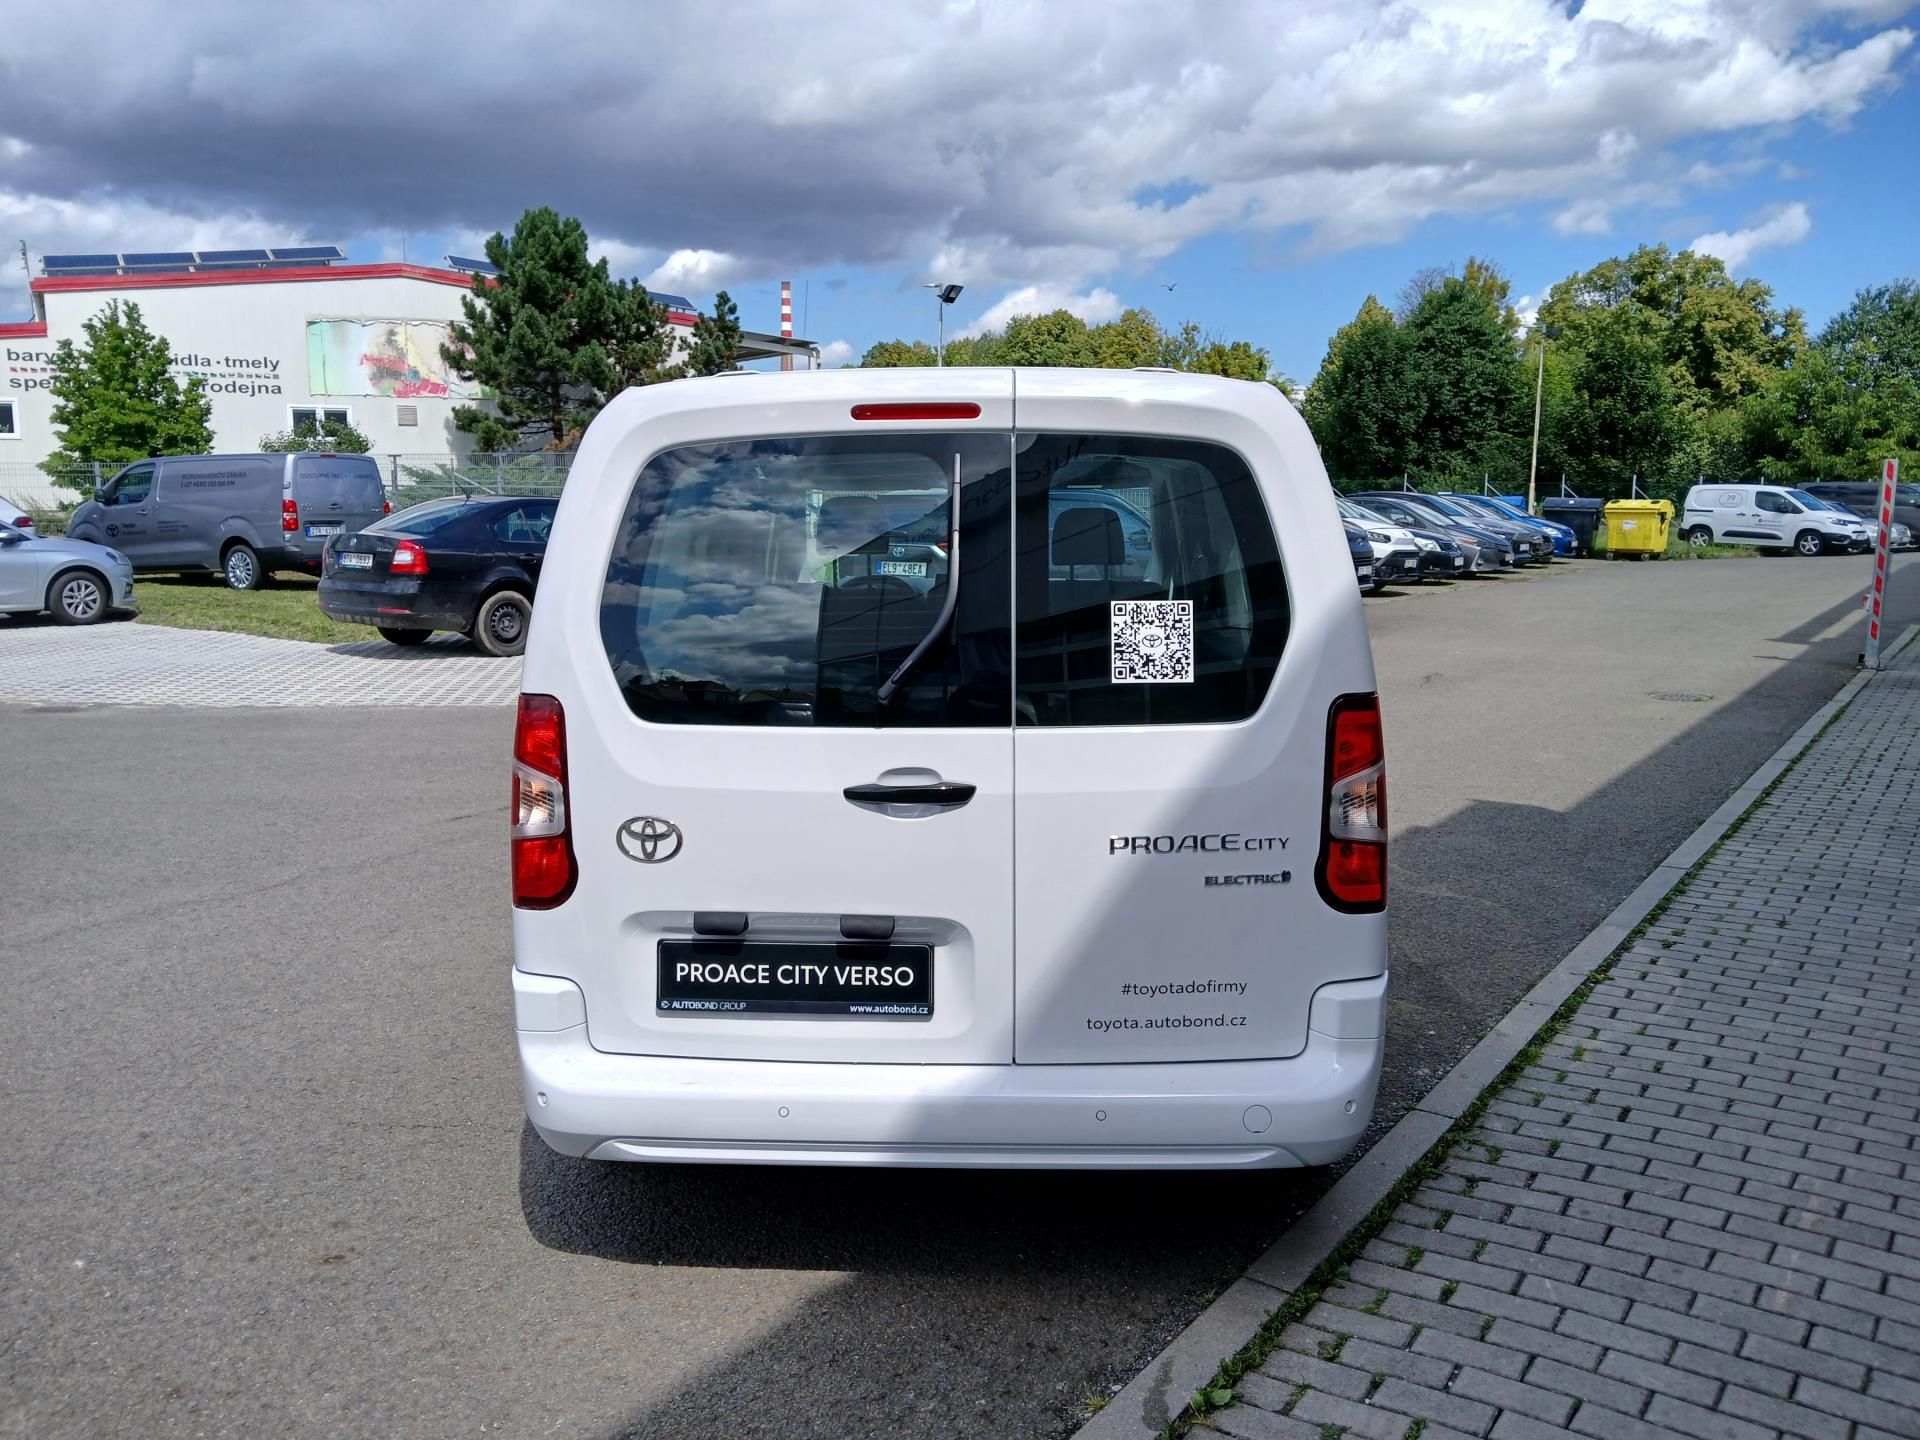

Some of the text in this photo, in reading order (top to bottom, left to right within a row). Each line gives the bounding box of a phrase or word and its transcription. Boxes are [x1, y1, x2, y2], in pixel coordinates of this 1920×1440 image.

[173, 353, 212, 367] idla
[224, 356, 280, 372] tmely
[882, 562, 897, 574] EL9
[1109, 834, 1290, 855] PROACE CITY
[1204, 873, 1282, 887] ELECTRIC
[676, 963, 914, 986] PROACE CITY VERSO
[1121, 980, 1248, 998] #toyotadofirmy
[671, 1001, 928, 1014] AUTOBOND GROUP www.autobond.cz
[1087, 1014, 1247, 1032] toyota.autobond.cz
